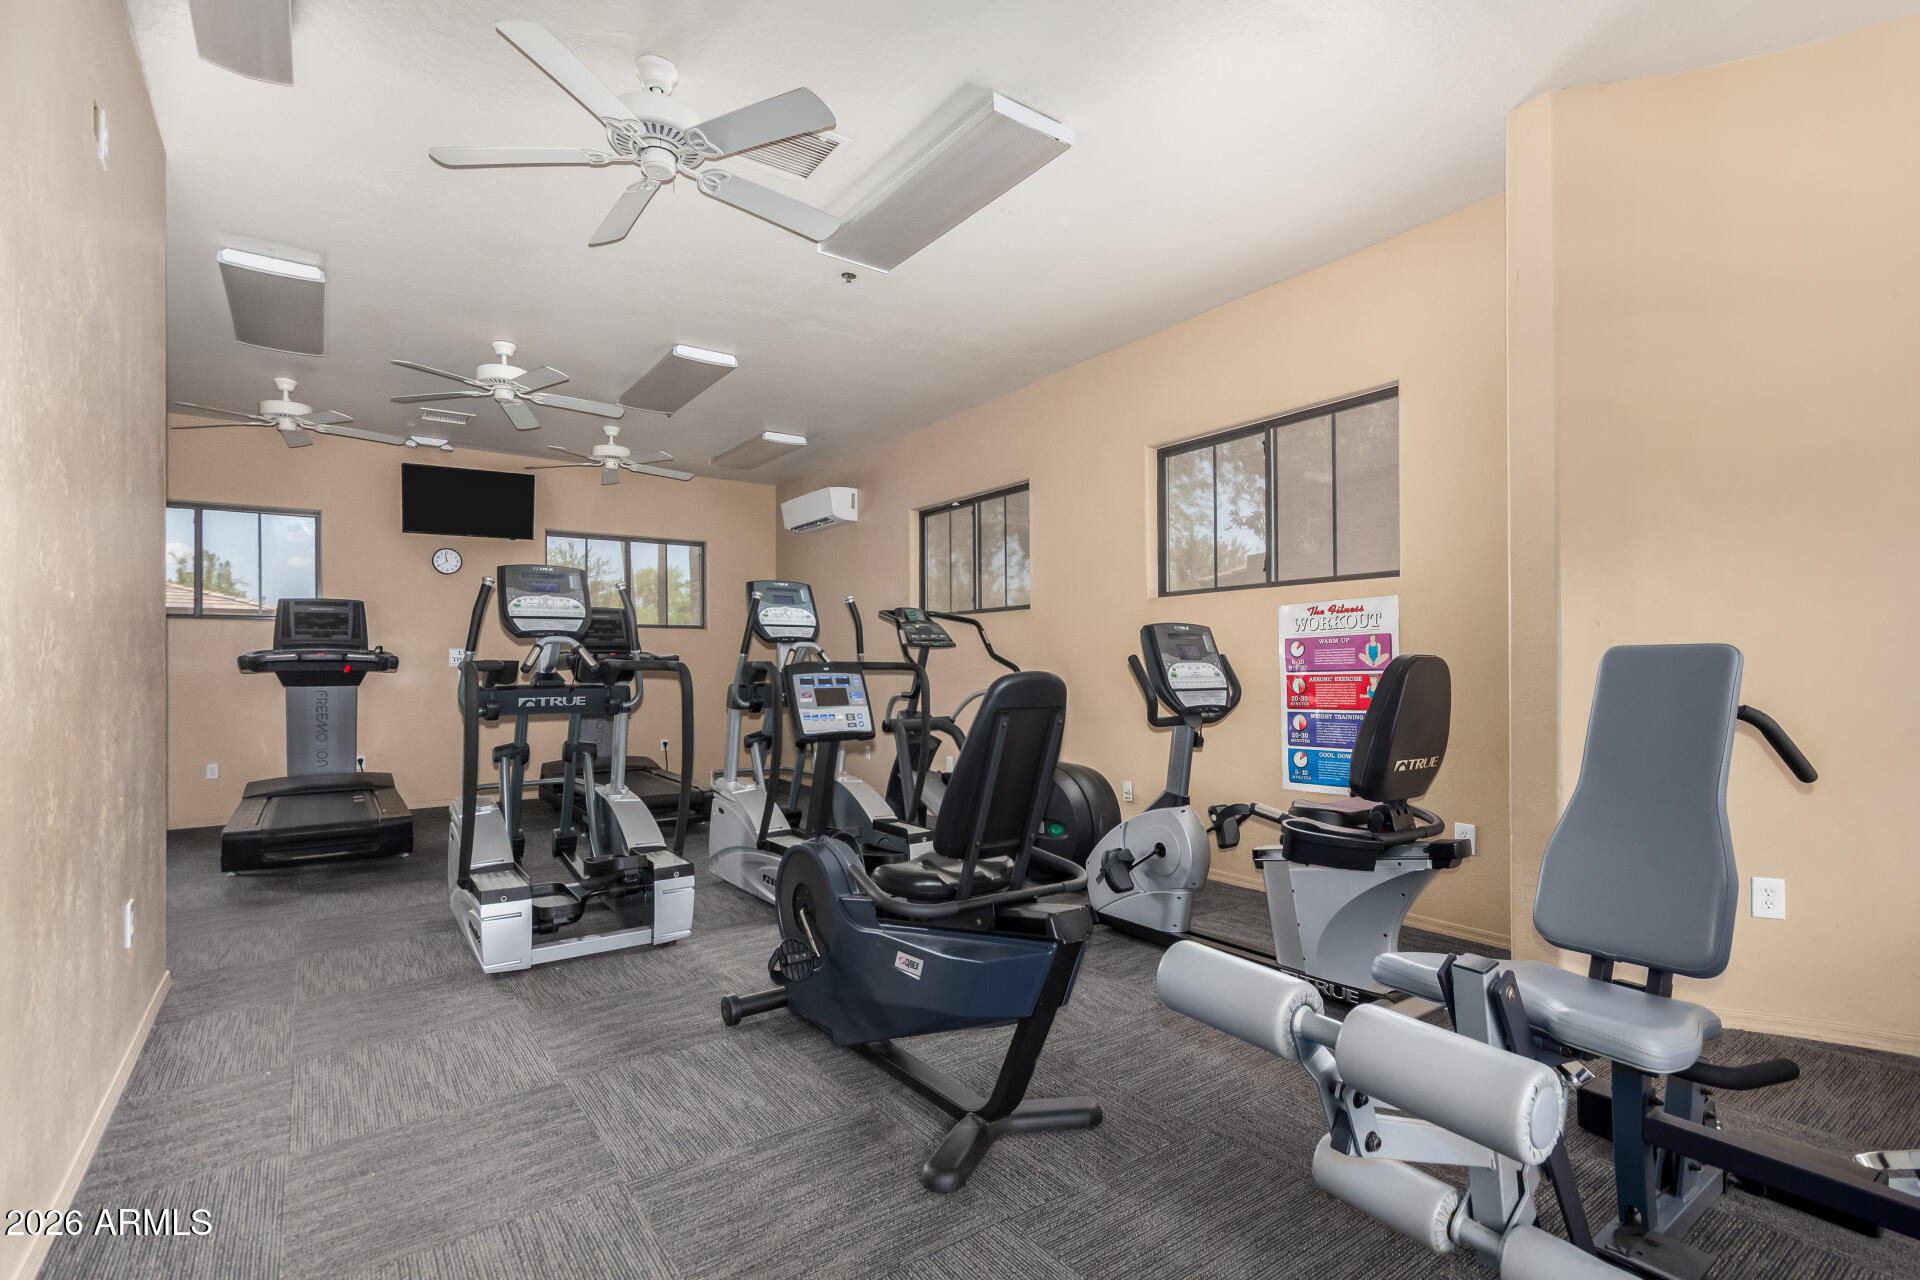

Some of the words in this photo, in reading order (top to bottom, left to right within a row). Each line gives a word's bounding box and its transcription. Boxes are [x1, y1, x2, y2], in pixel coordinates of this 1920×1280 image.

[1307, 605, 1325, 616] The
[1327, 603, 1365, 615] Fitness
[1294, 612, 1382, 632] WORKOUT
[536, 696, 586, 707] TRUE
[1334, 713, 1364, 721] TRAINING
[315, 690, 329, 768] FREEMOION
[1408, 755, 1440, 771] TRUE
